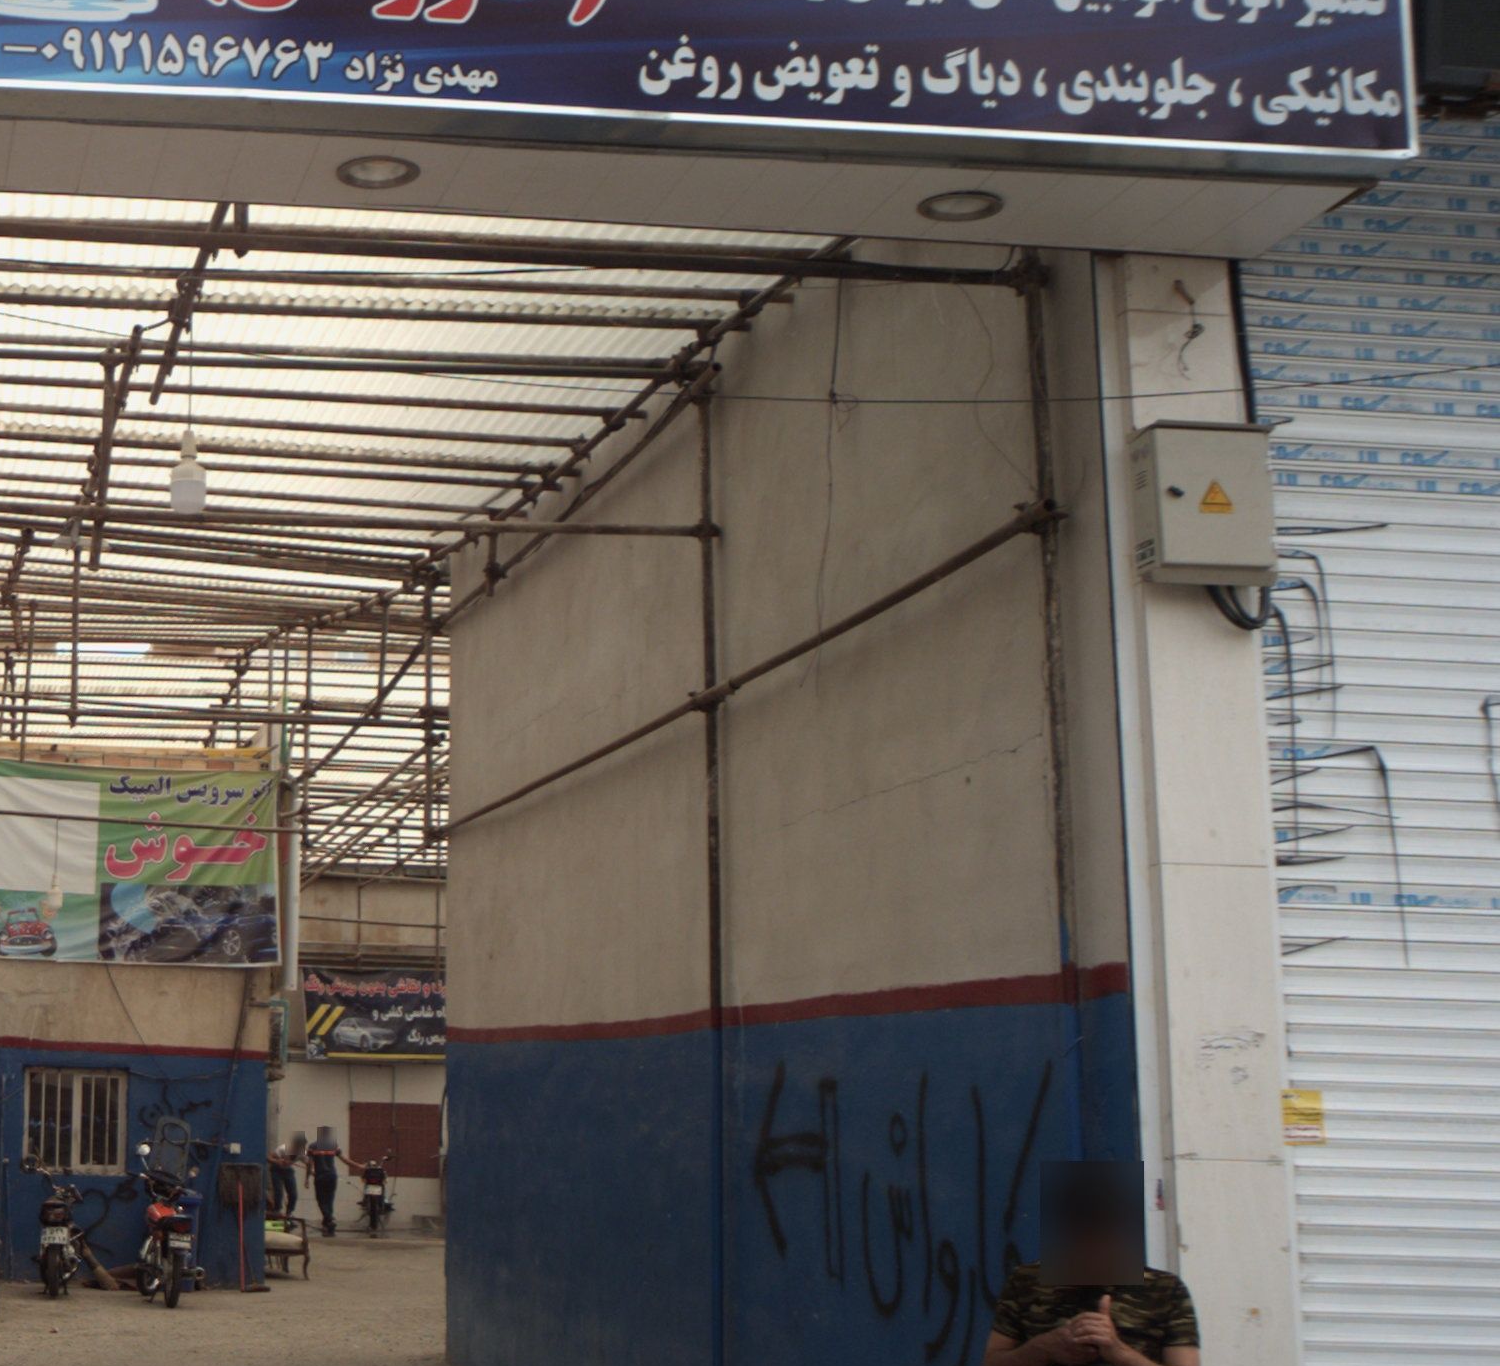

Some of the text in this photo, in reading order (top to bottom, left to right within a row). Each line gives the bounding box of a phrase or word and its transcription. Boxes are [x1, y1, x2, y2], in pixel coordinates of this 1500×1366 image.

[39, 27, 334, 83] ۰۹۱۲۱۵۹۶۷۶۳
[344, 50, 406, 93] نژاد
[413, 61, 499, 95] مهدی
[638, 34, 744, 101] روغن
[753, 40, 880, 106] تعویض
[922, 46, 1023, 108] دیاگ
[889, 63, 913, 108] و
[1057, 56, 1218, 120] جلوبندی
[1252, 65, 1402, 126] مکانیکی
[108, 774, 172, 804] المپیک
[175, 783, 246, 807] سرویس
[103, 811, 269, 882] خوش
